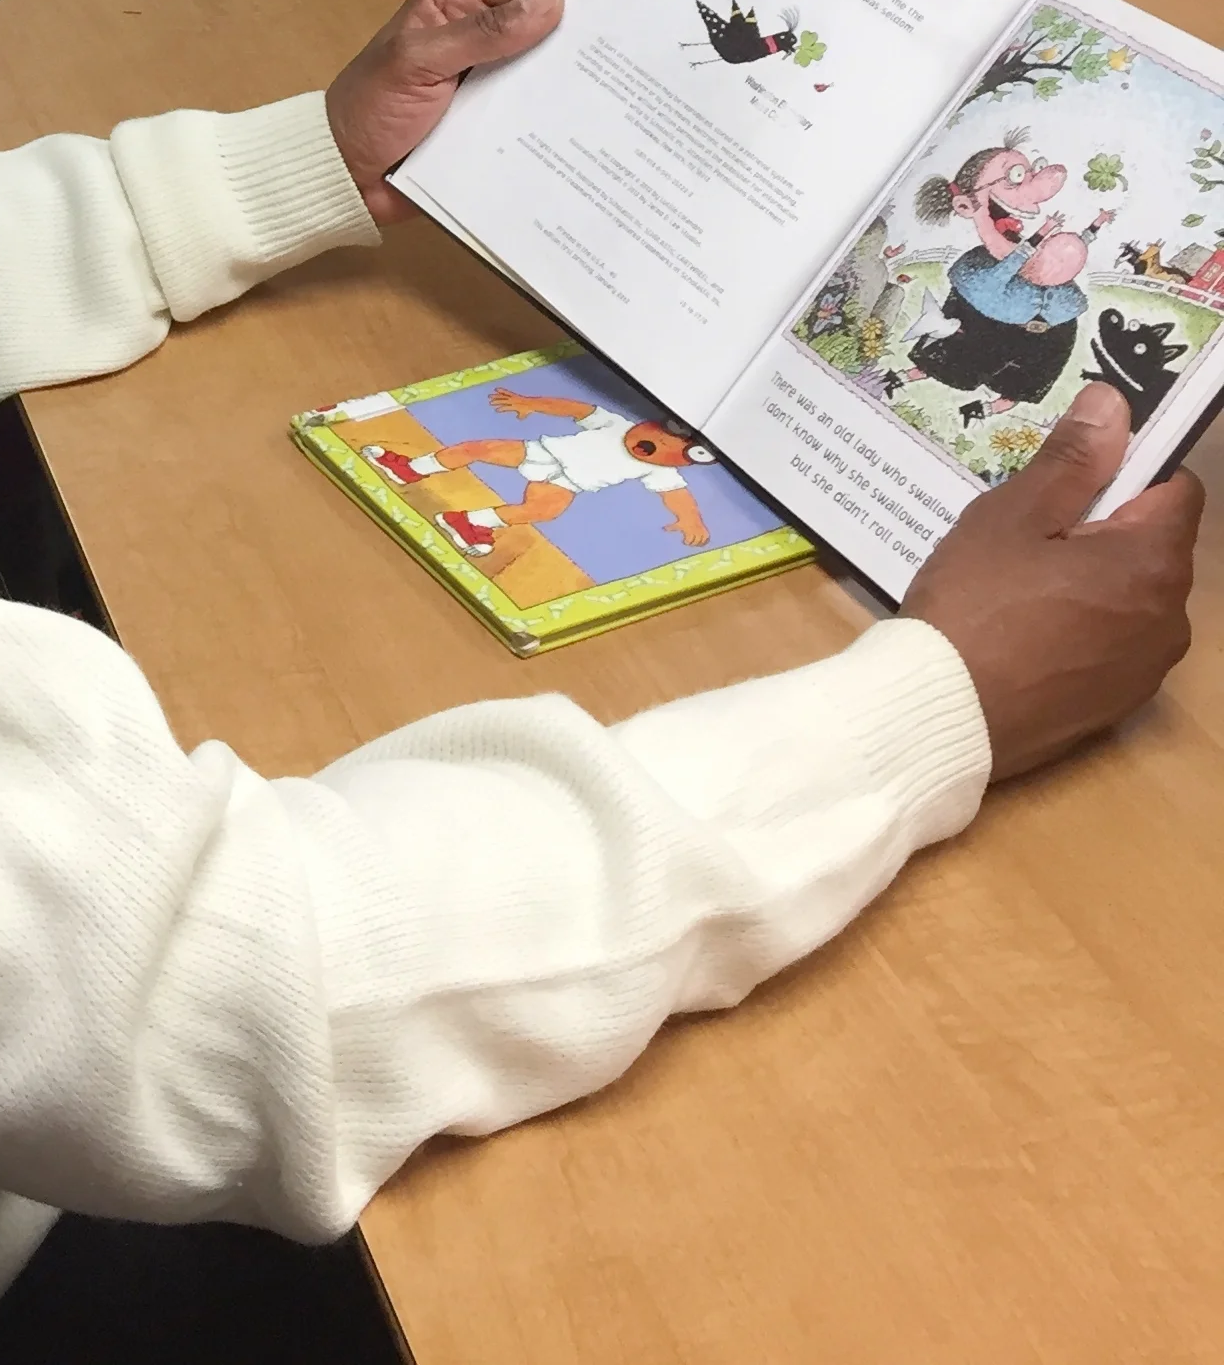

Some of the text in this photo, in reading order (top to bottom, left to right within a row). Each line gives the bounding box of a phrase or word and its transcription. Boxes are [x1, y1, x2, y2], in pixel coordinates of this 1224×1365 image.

[907, 7, 925, 23] the
[766, 403, 794, 428] don't
[792, 422, 823, 451] know
[823, 448, 849, 474] why
[847, 469, 871, 491] she
[870, 488, 933, 540] swallowed
[771, 371, 797, 398] There
[796, 393, 818, 415] was
[817, 411, 834, 429] an
[833, 424, 855, 444] old
[853, 438, 882, 467] lady
[881, 462, 908, 487] who
[790, 454, 812, 477] but
[811, 473, 834, 494] she
[833, 491, 869, 525] didn't
[868, 520, 893, 543] roll
